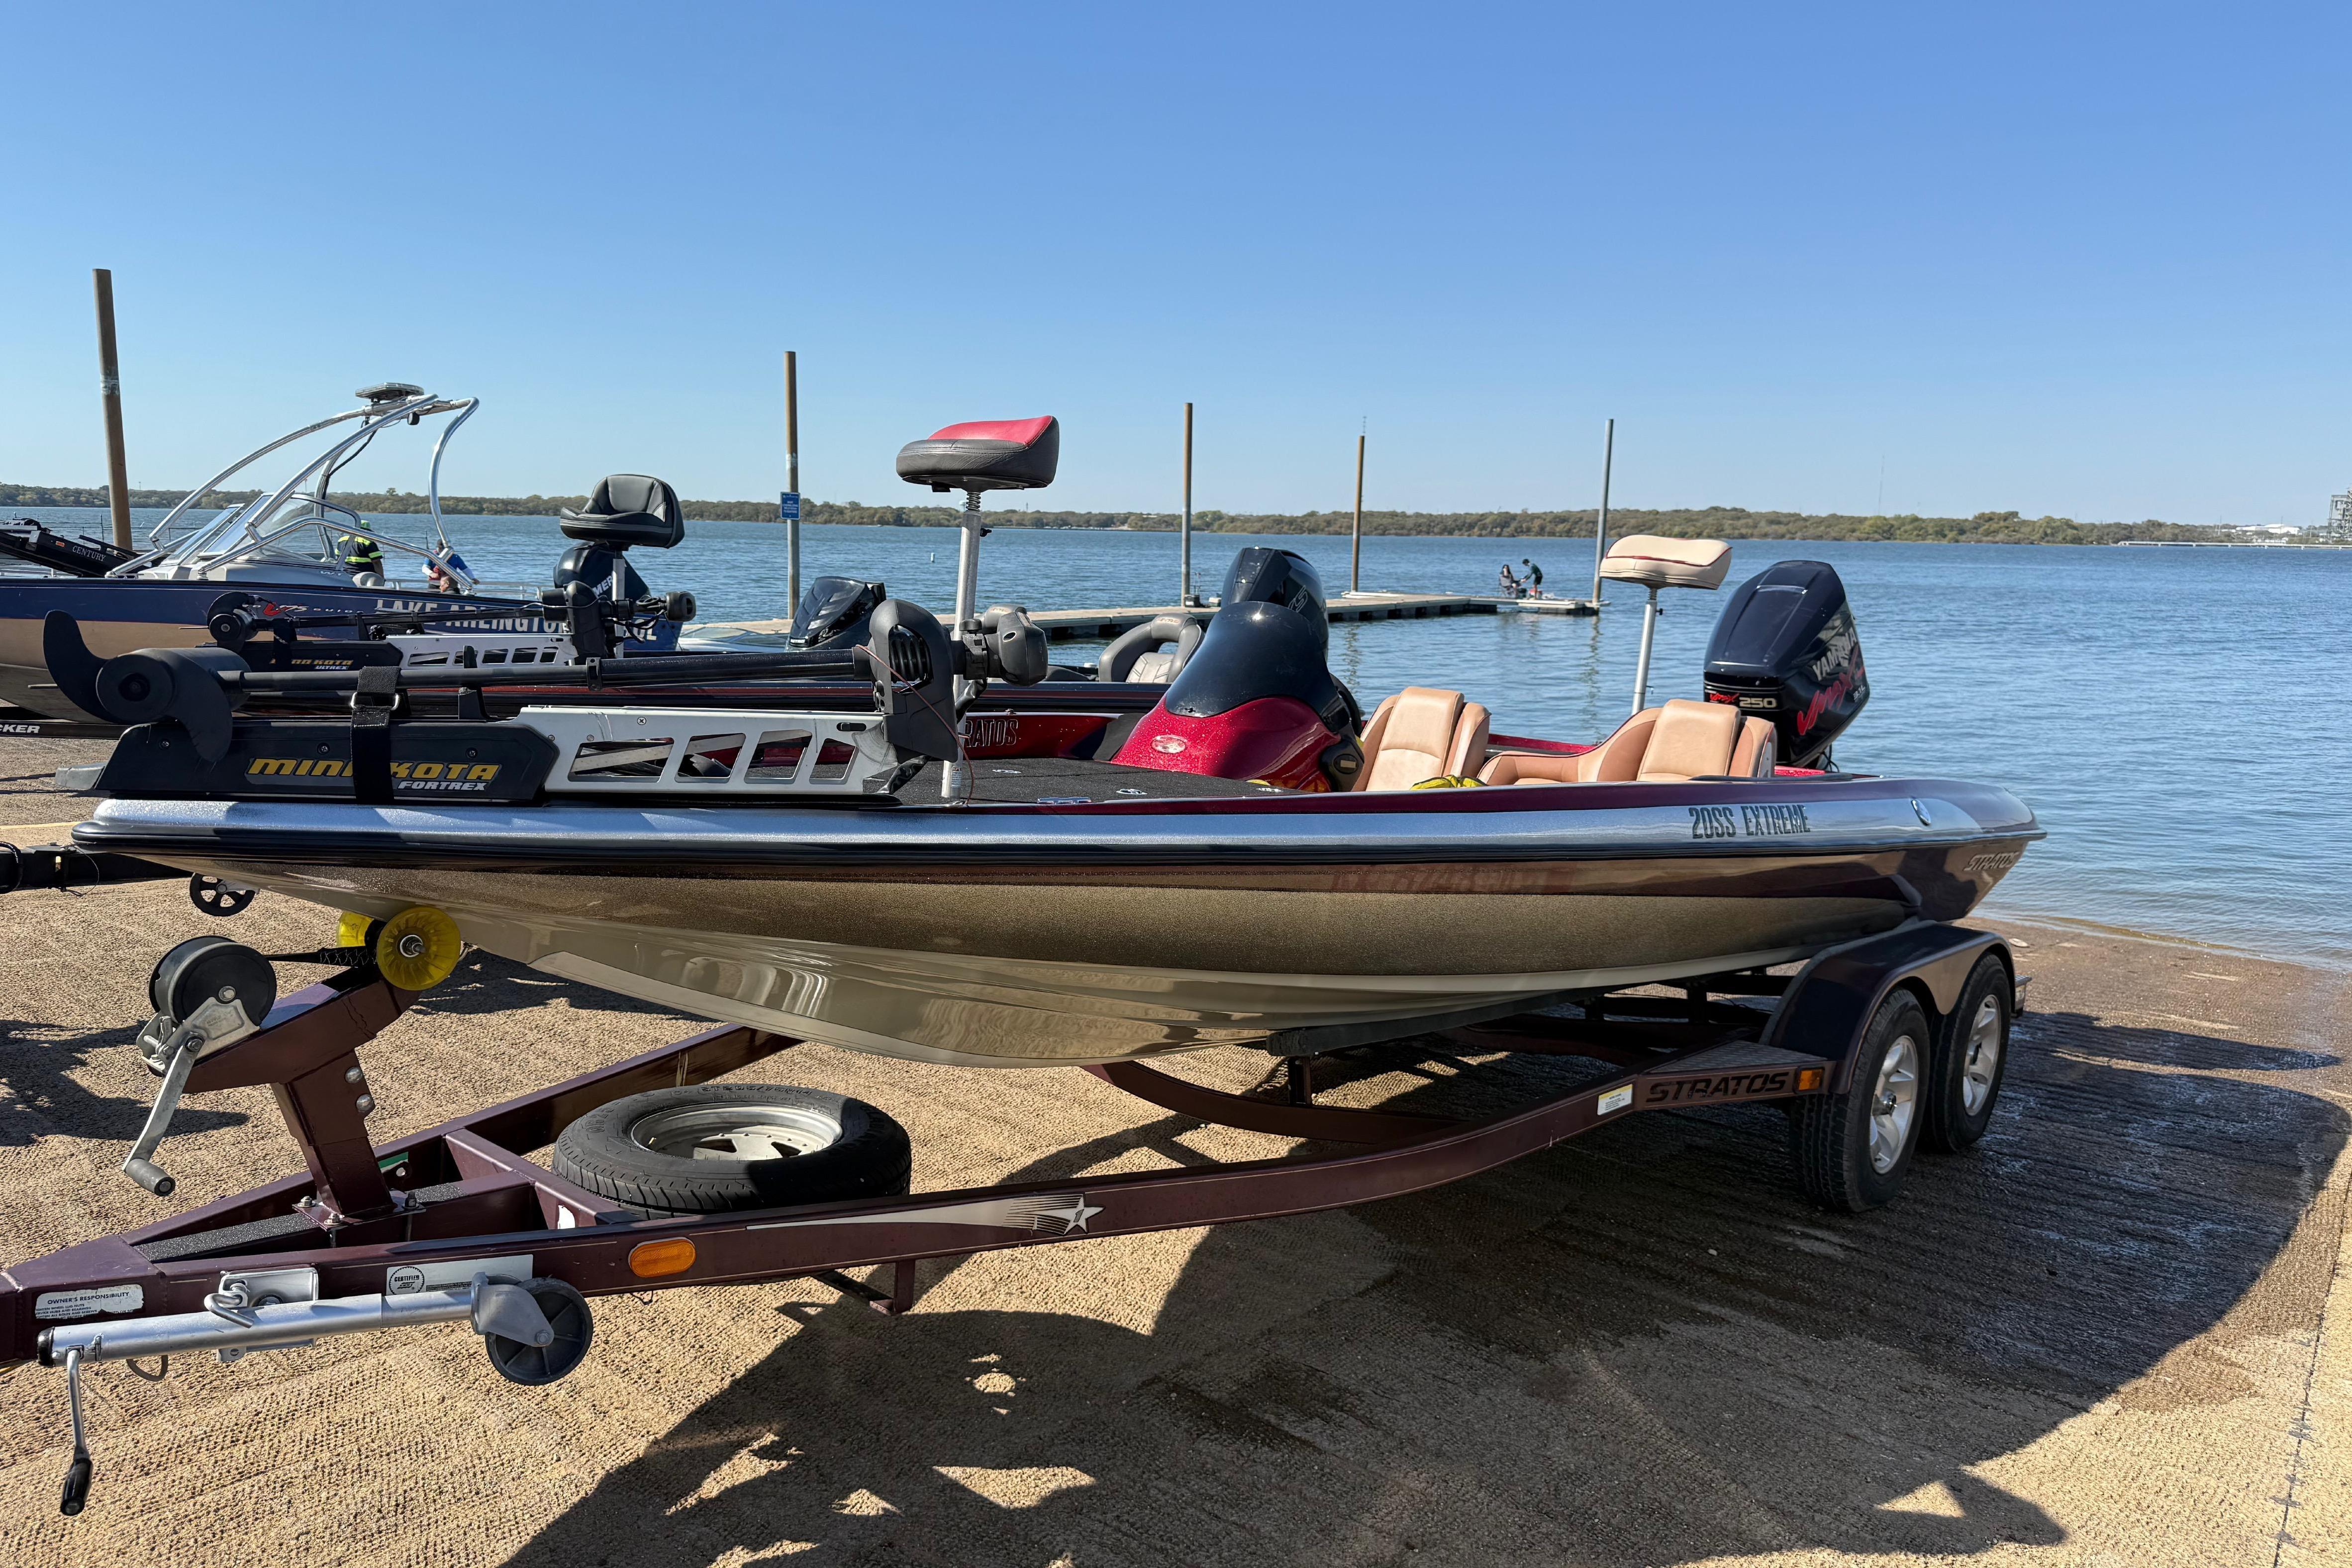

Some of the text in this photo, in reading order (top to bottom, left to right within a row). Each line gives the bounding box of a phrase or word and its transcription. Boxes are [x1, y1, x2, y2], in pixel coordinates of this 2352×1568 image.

[72, 545, 106, 562] CENTURY
[1739, 697, 1777, 708] 250
[965, 719, 1018, 747] RATOS
[390, 762, 499, 780] KOTA
[398, 781, 489, 790] FORTREX
[1740, 804, 1811, 836] EXTREME
[1962, 851, 2020, 872] STRATOS
[1646, 1072, 1789, 1103] STRATOS
[80, 1291, 129, 1301] RESPONSIBILITY
